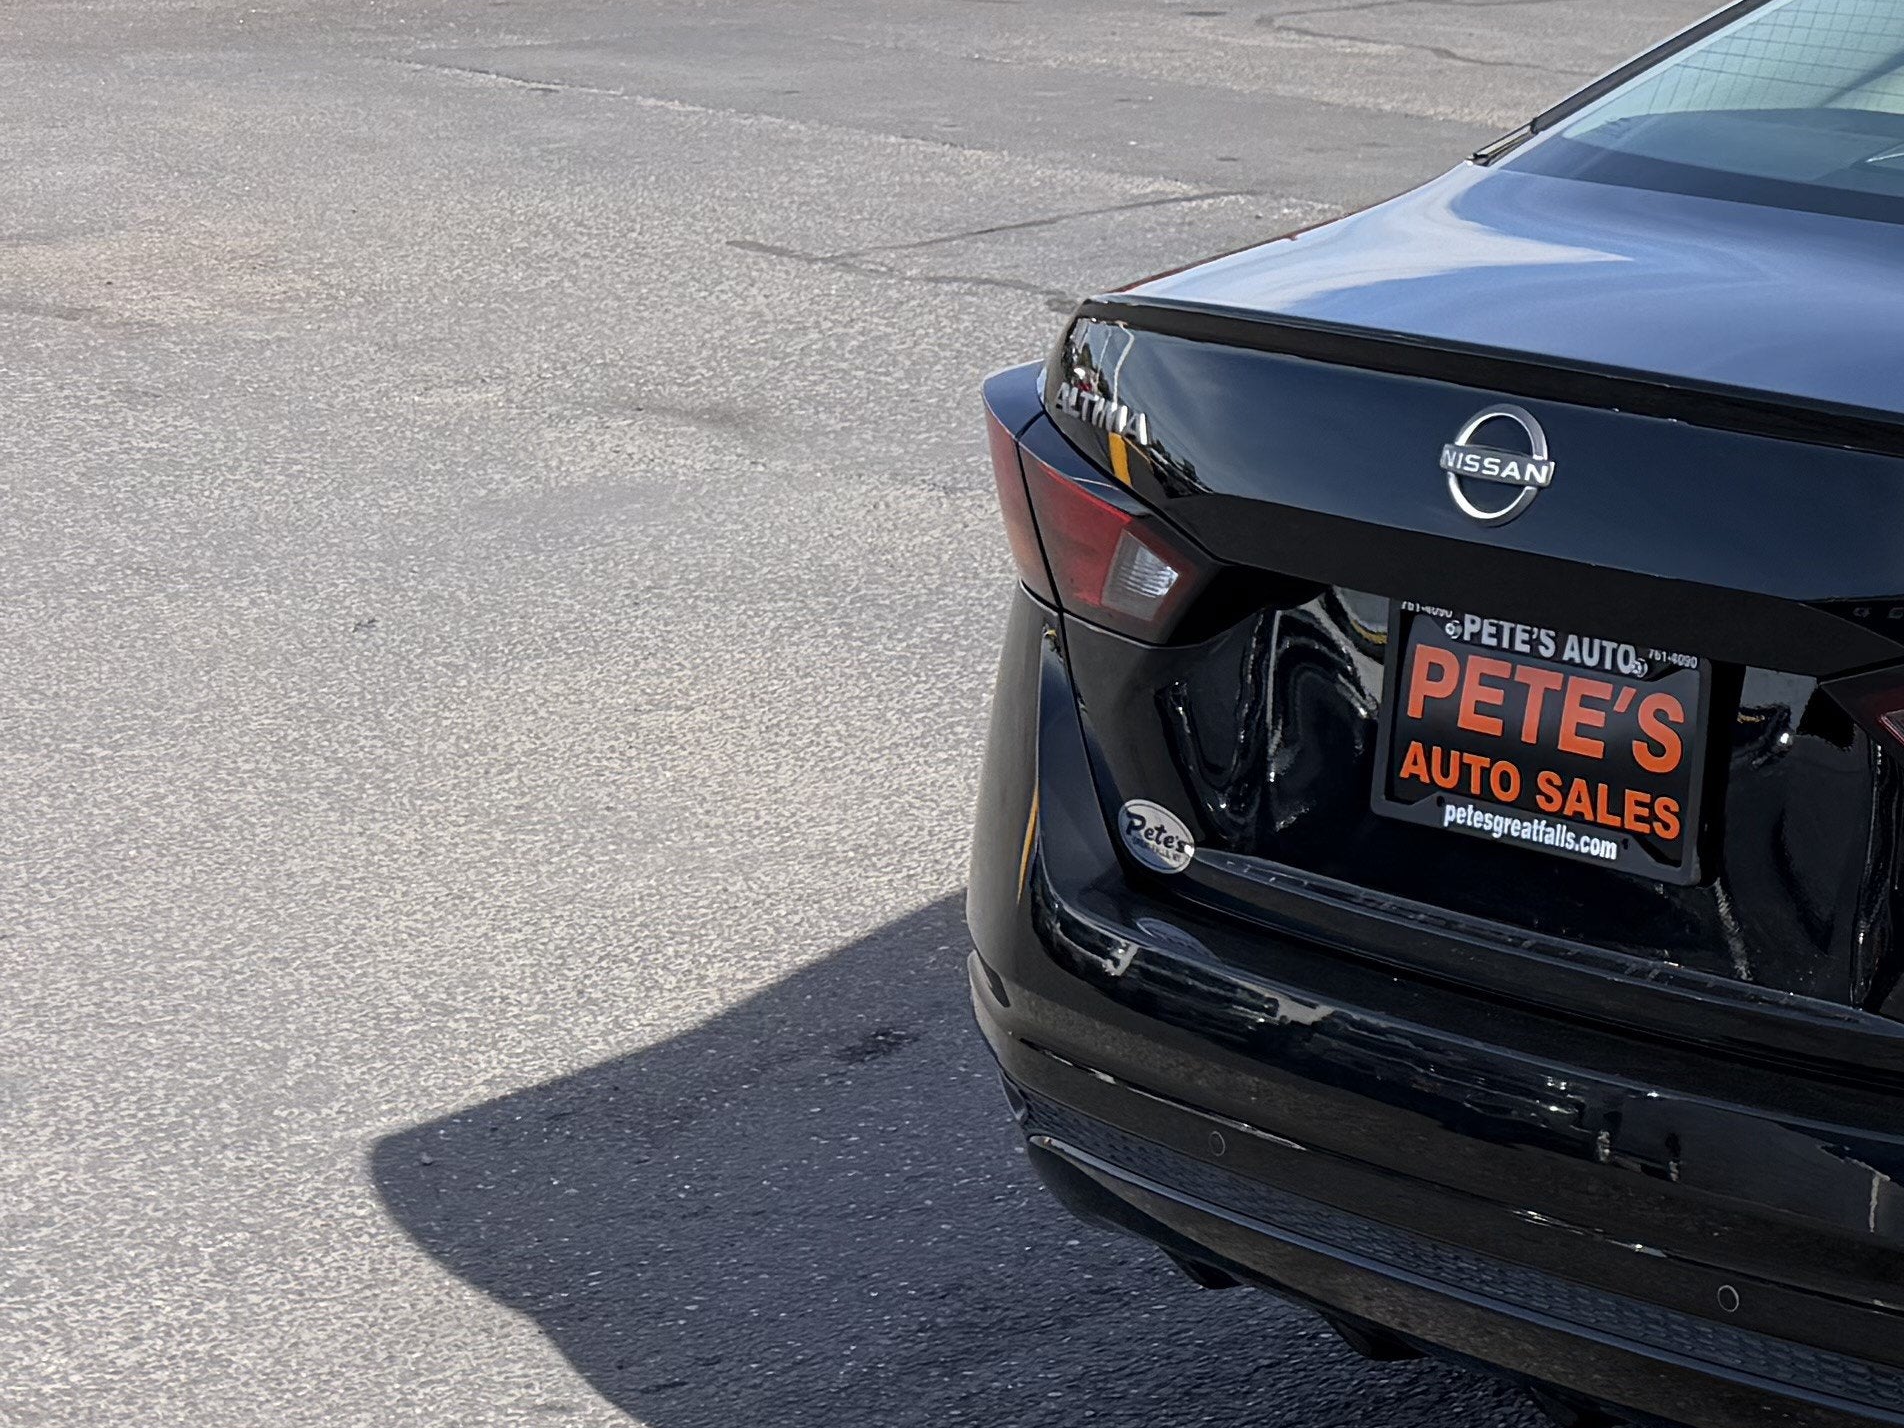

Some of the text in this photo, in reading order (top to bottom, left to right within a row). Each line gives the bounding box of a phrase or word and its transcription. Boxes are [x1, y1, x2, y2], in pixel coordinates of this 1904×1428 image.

[1056, 382, 1148, 445] ALTIMA
[1441, 450, 1549, 483] NISSAN
[1463, 614, 1639, 675] PETE'S AUTO
[1407, 643, 1686, 773] PETE'S
[1400, 741, 1681, 839] AUTO SALES
[1125, 808, 1190, 853] Pete's
[1443, 803, 1617, 860] petesgreatfalls.com
